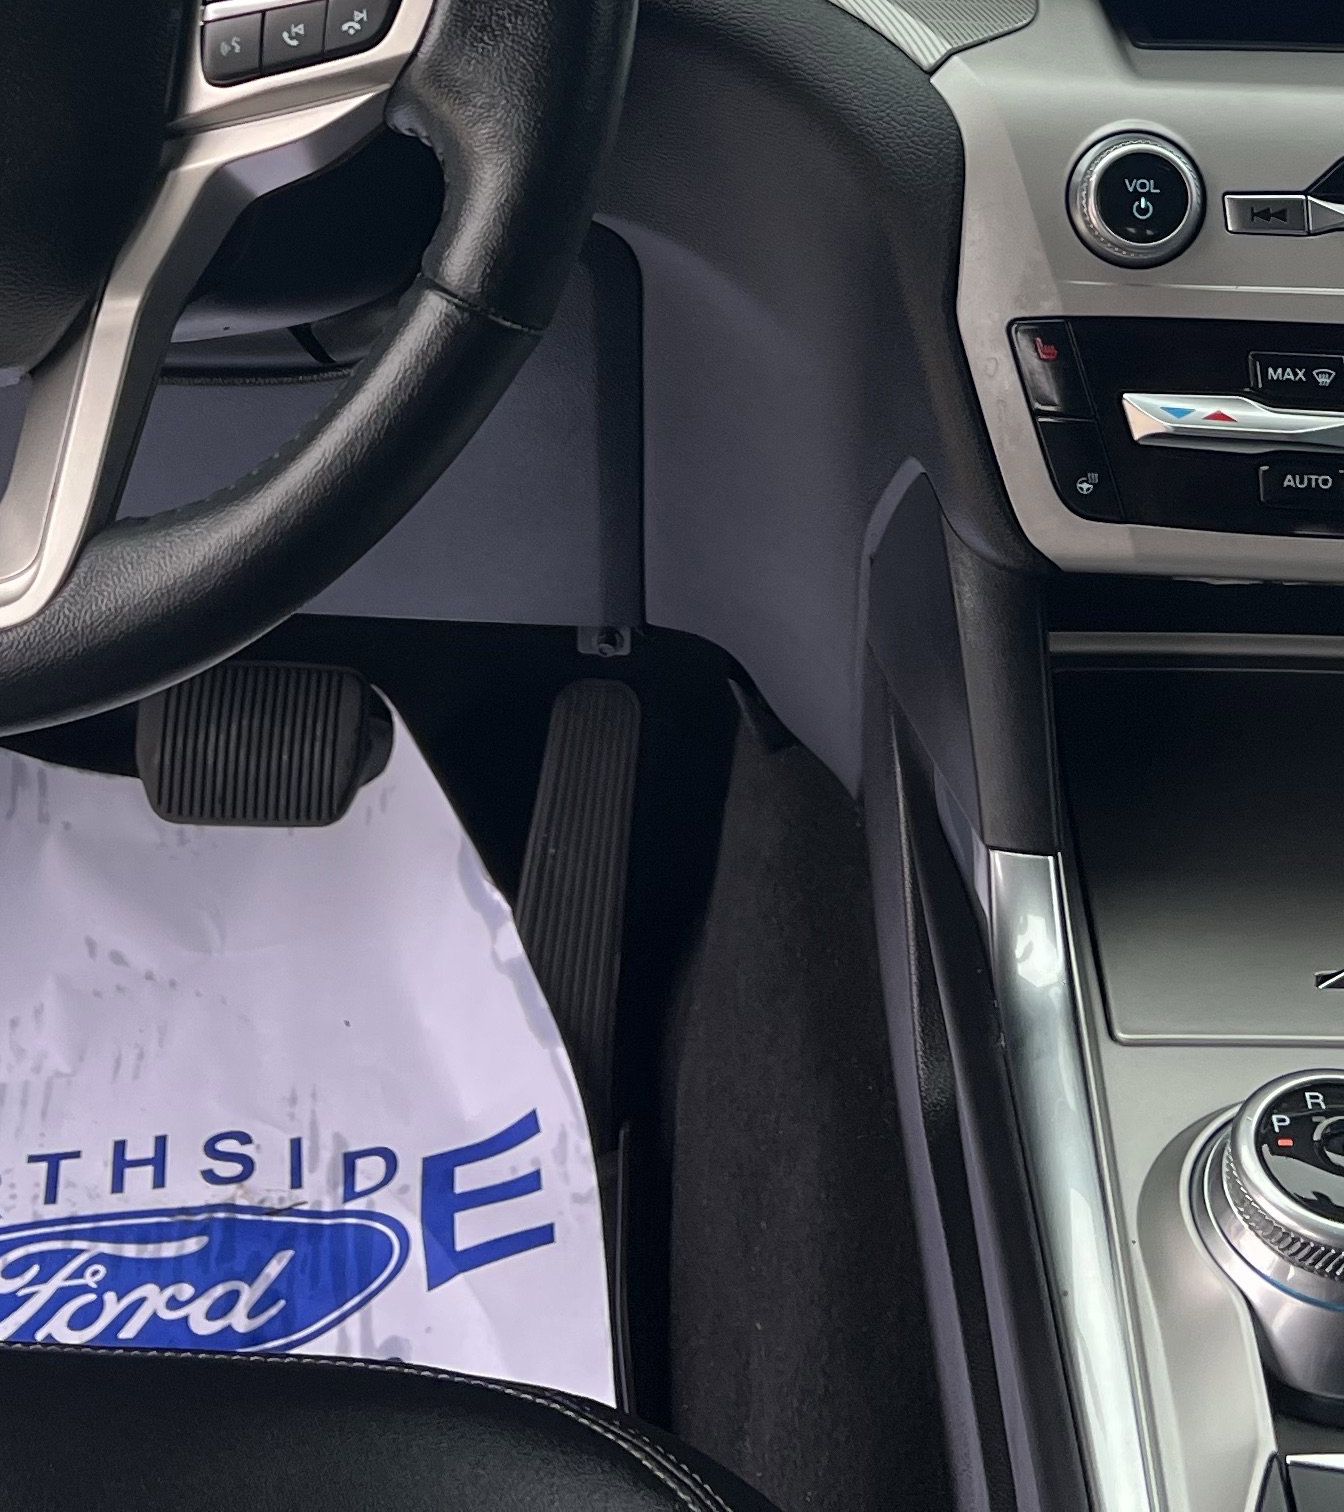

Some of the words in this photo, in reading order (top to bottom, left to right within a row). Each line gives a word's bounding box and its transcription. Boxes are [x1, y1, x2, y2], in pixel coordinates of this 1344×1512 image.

[1124, 178, 1161, 193] VOL
[1267, 367, 1307, 383] MAX
[1283, 474, 1333, 490] AUTO
[1304, 1091, 1326, 1110] R
[1271, 1114, 1291, 1133] P
